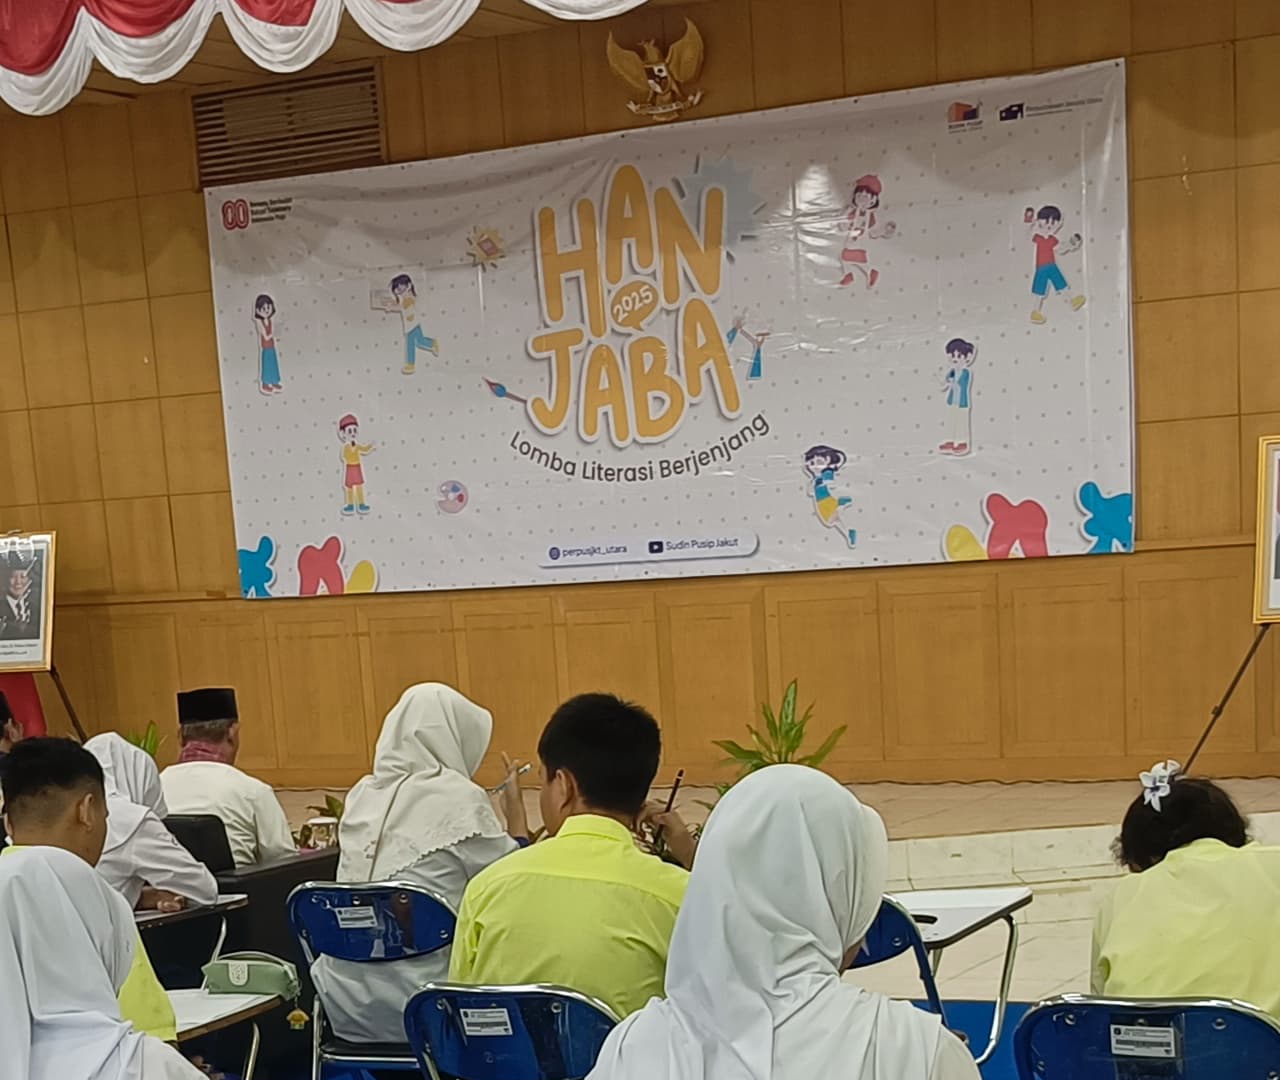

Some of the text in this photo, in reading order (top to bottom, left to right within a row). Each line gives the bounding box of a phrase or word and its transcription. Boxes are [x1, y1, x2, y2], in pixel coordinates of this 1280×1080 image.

[538, 164, 724, 338] HAN
[613, 284, 653, 323] 2025
[530, 298, 741, 442] JABA
[510, 413, 770, 482] Lomba Literasi Berjenjang
